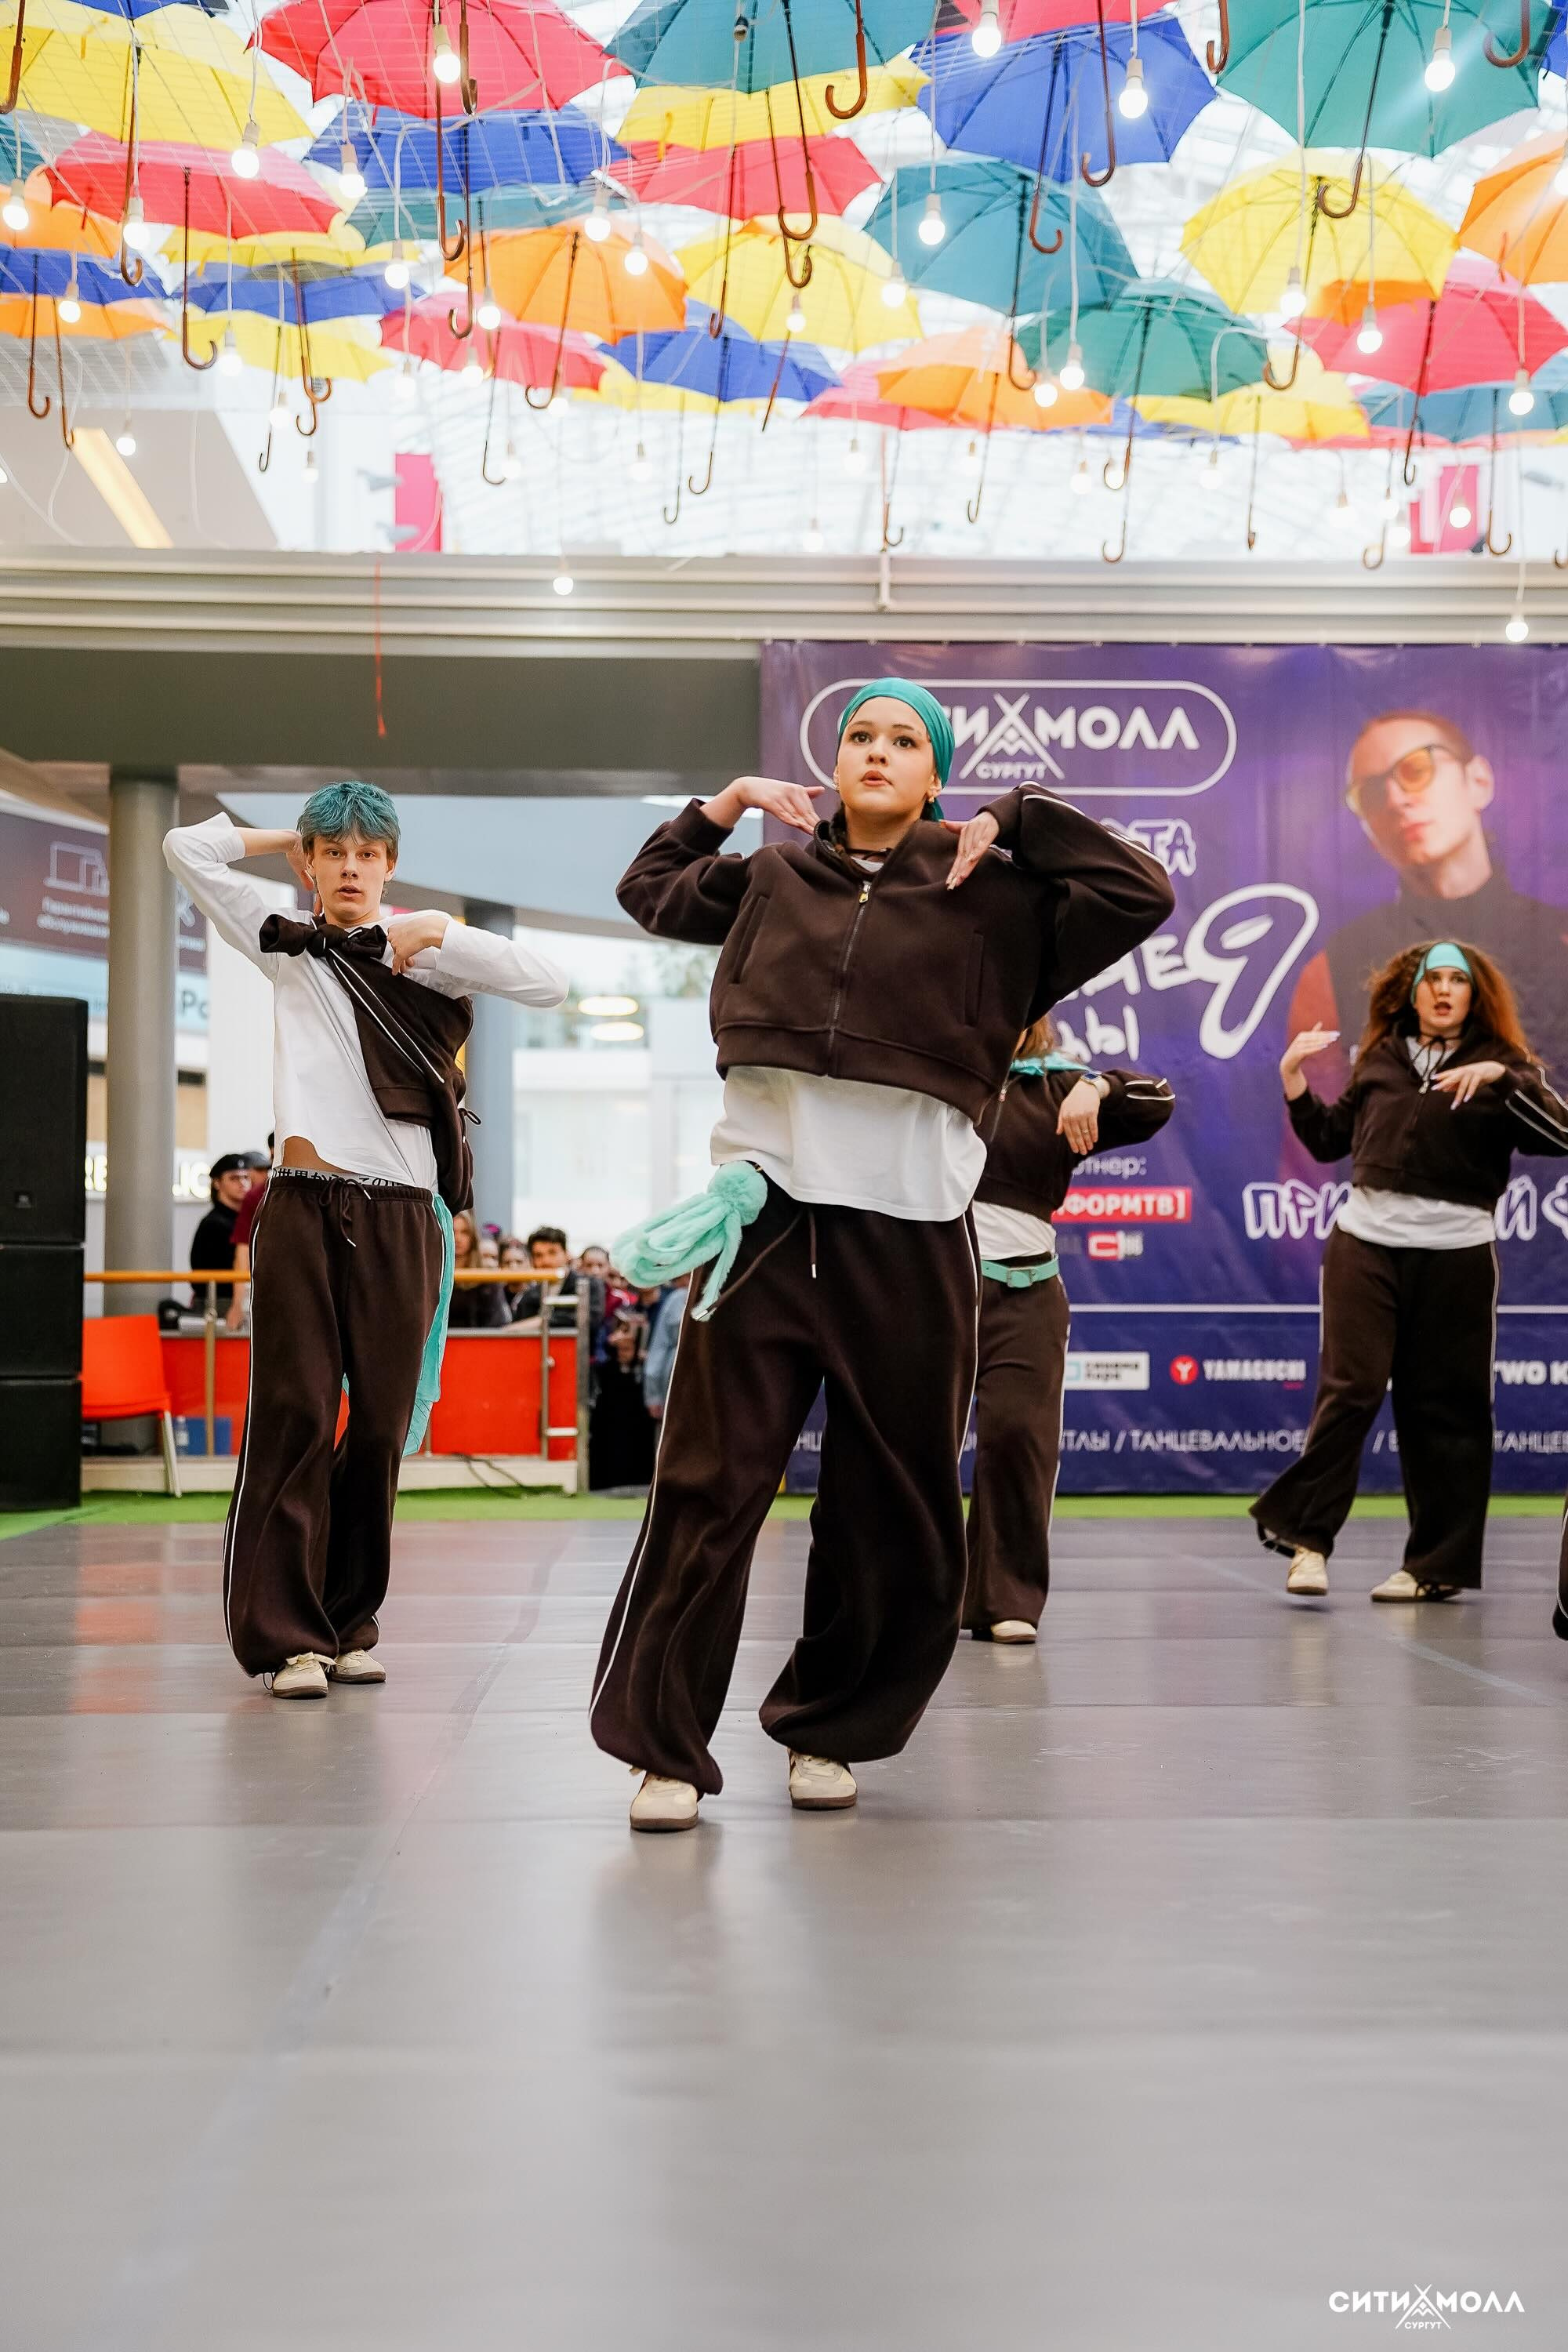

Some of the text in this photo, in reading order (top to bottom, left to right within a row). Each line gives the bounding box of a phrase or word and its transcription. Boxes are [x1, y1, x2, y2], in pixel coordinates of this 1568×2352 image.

[1034, 705, 1200, 750] МОЛЛ
[1056, 1190, 1186, 1219] ФОРМТВ]
[1129, 1429, 1305, 1454] ТАНЦЕВАЛЬНОЕ
